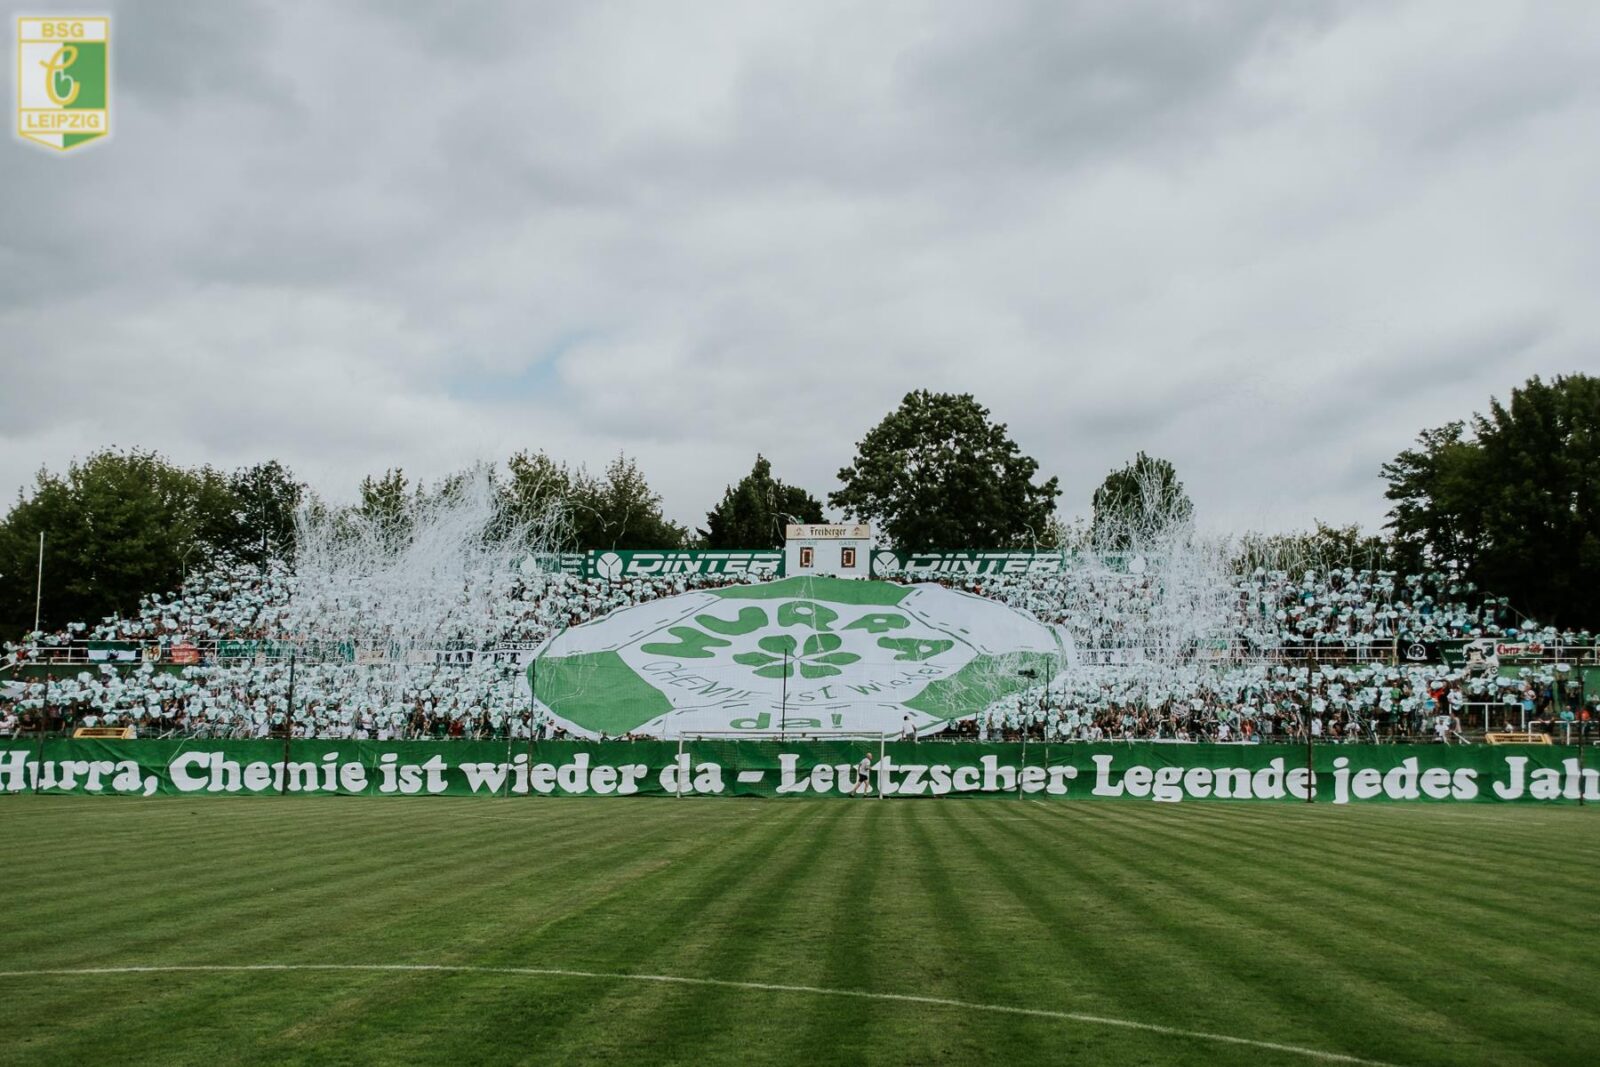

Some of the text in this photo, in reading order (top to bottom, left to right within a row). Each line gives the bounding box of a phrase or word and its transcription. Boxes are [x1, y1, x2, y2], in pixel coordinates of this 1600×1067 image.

[810, 526, 847, 537] Freiberger
[626, 553, 782, 573] DINTER
[844, 549, 855, 566] 0
[904, 553, 1063, 573] DINTER
[642, 661, 773, 699] CHEMIE
[729, 711, 843, 730] da!
[0, 750, 158, 797] Hurra,
[169, 751, 368, 793] Chemie
[379, 753, 448, 793] ist
[458, 752, 648, 794] wieder
[659, 753, 725, 794] da
[776, 753, 1078, 795] Leutzscher
[1092, 754, 1317, 804] Legende
[1331, 757, 1479, 804] jedes
